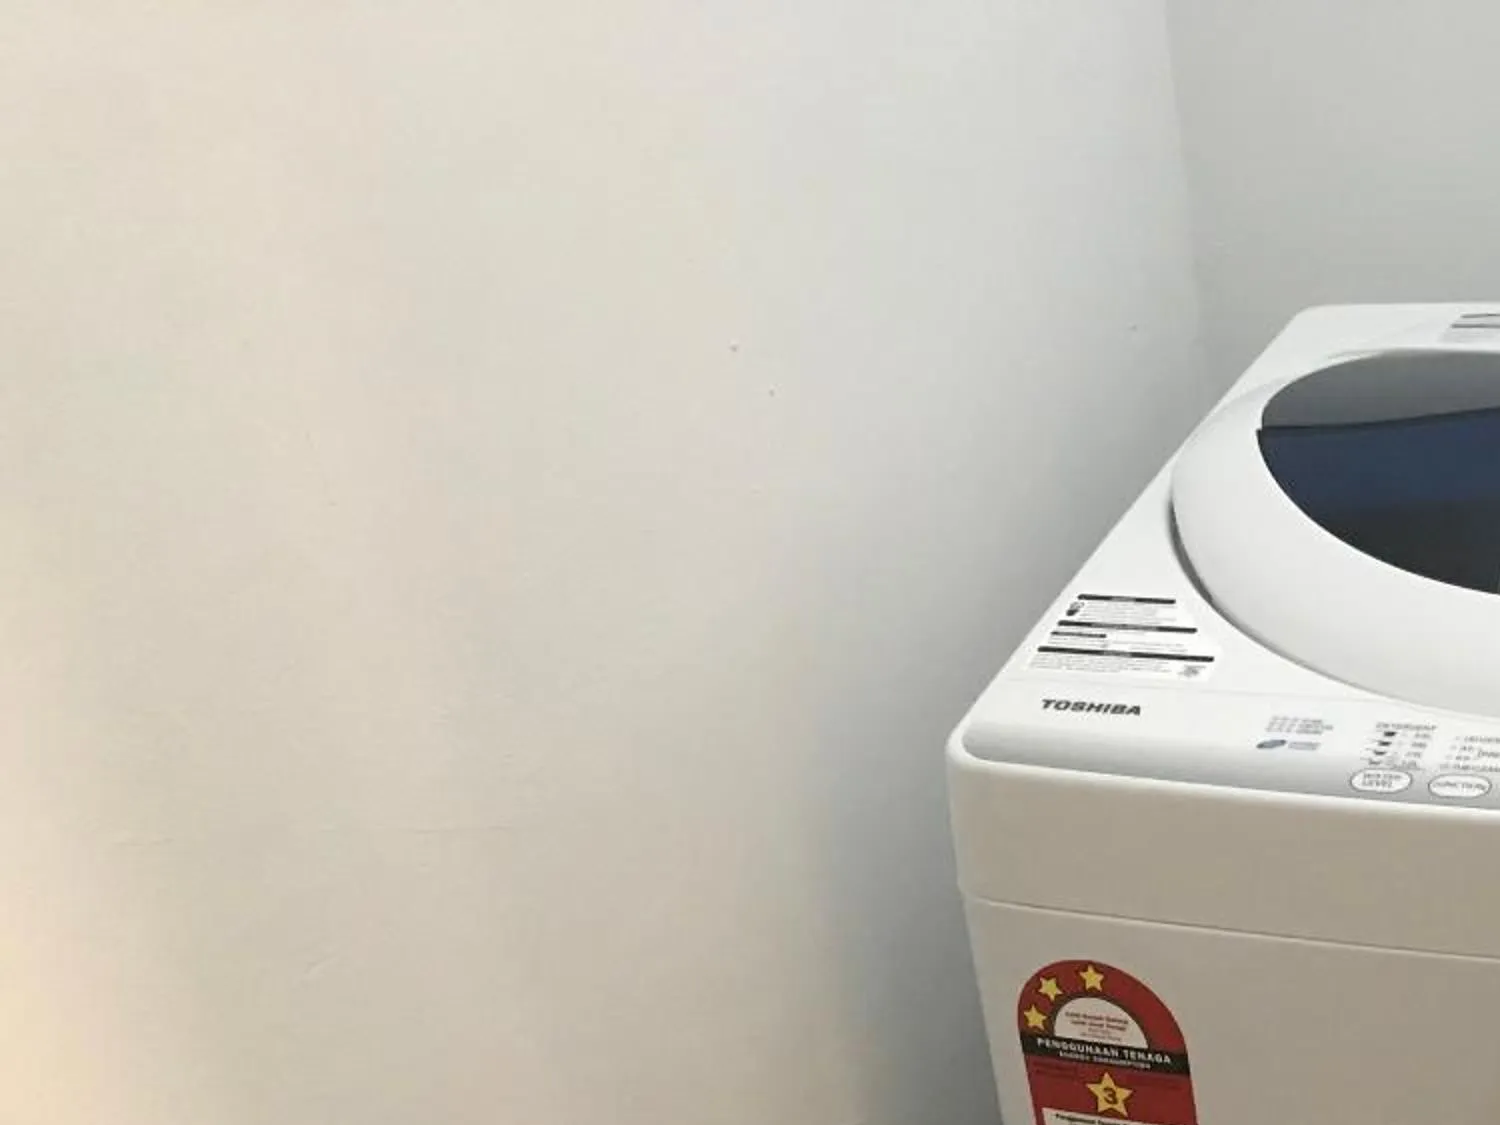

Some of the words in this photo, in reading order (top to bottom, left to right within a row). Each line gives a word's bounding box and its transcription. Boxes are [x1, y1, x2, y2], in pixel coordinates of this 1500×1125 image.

[1041, 699, 1141, 716] TOSHIBA
[1036, 1037, 1120, 1058] PENGGUNAAN
[1122, 1049, 1171, 1065] TENAGA
[1102, 1086, 1118, 1104] 3
